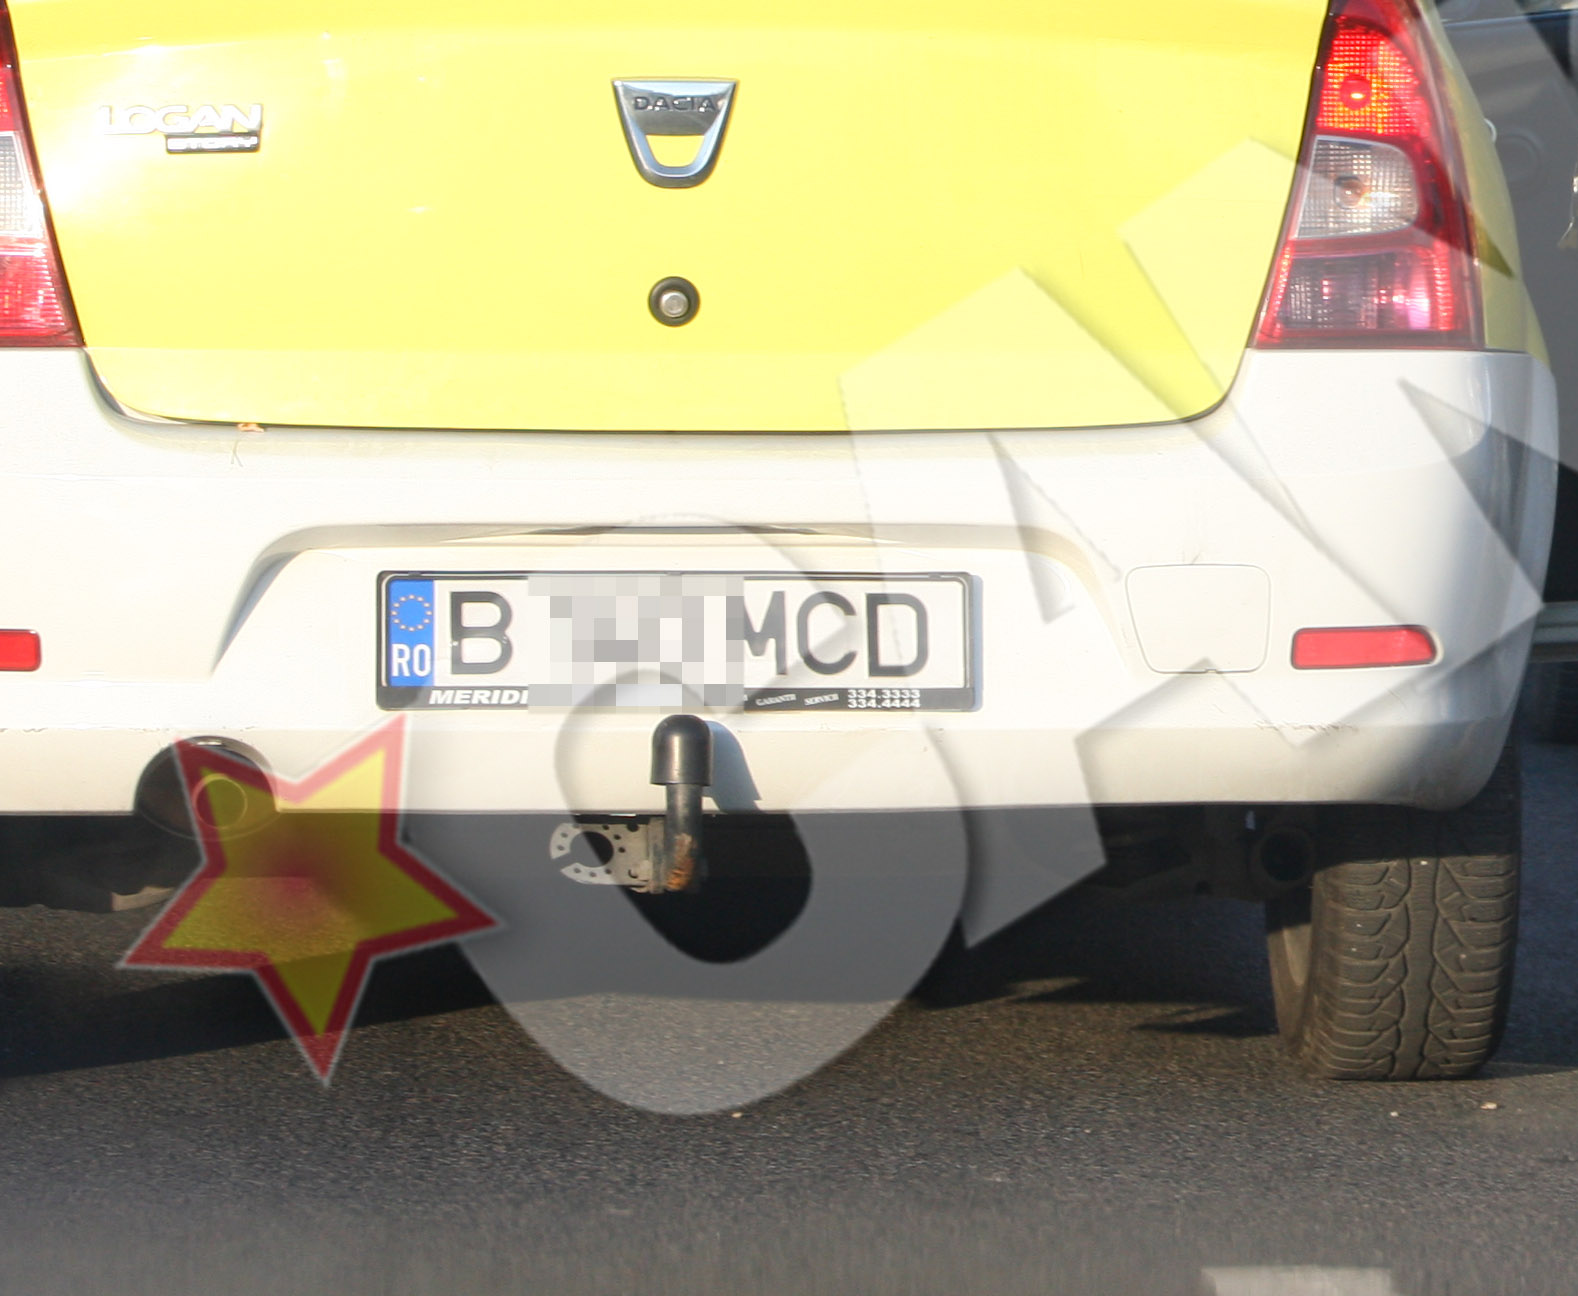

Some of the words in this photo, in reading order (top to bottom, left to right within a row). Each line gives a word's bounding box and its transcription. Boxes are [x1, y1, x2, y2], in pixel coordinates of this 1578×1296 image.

[98, 103, 263, 135] LOGAN
[633, 95, 717, 112] DACIA
[449, 590, 514, 676] B
[391, 642, 432, 678] RO
